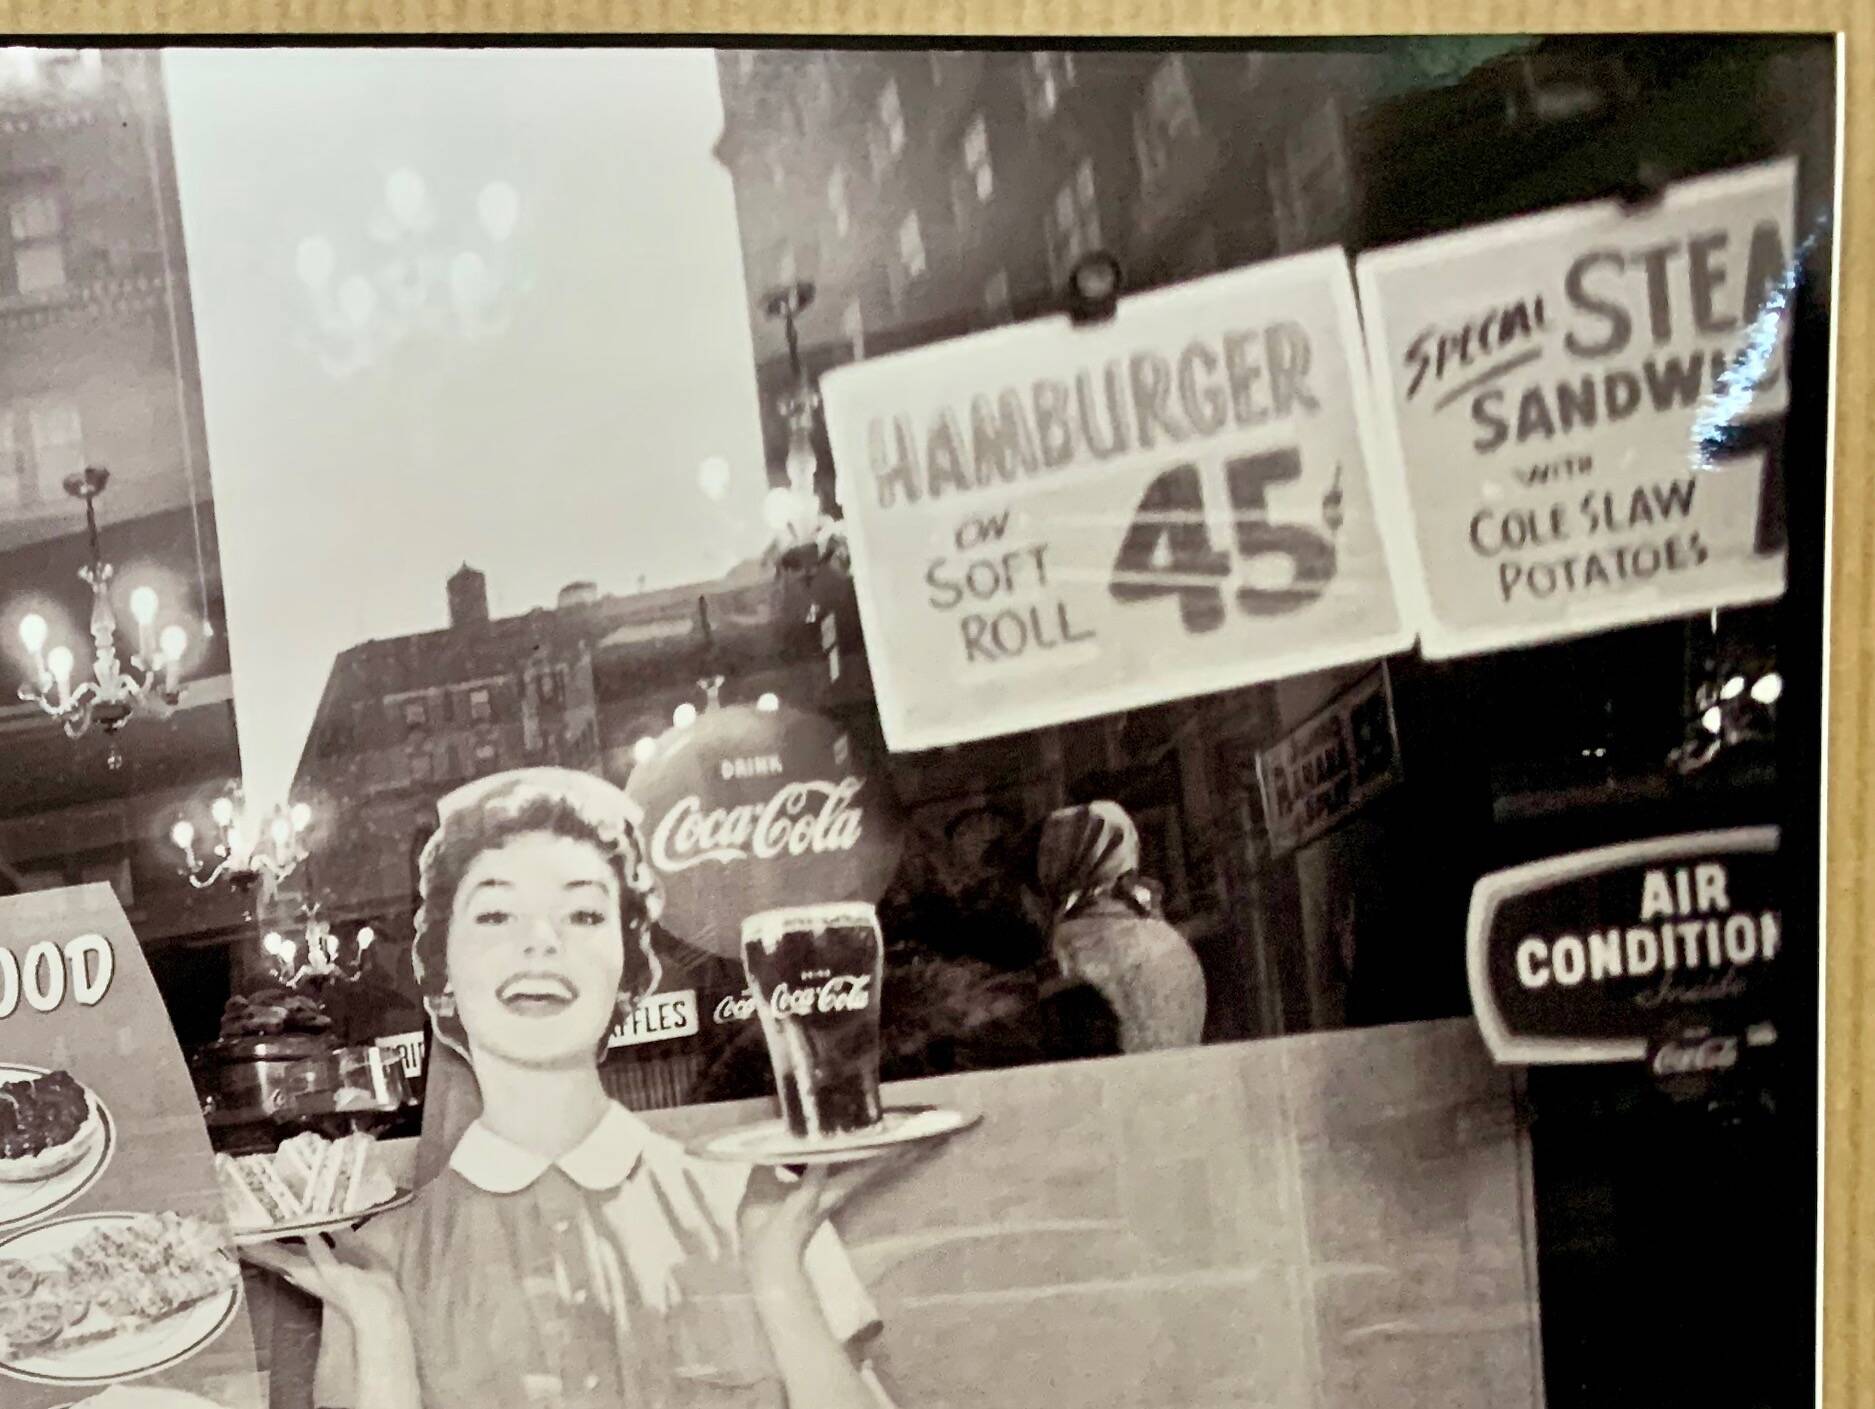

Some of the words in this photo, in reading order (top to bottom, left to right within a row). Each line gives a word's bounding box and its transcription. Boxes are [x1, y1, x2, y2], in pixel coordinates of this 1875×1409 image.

[867, 320, 1321, 509] HAMBURGER
[1470, 347, 1781, 455] SANDWI
[1515, 454, 1593, 487] WITH
[954, 509, 1011, 552] ON
[1469, 501, 1568, 557] COLE
[1582, 476, 1697, 536] SLAW
[925, 543, 1050, 611] SOFT
[1498, 531, 1709, 603] POTATOES
[961, 601, 1098, 663] ROLL
[1639, 862, 1730, 921] AIR
